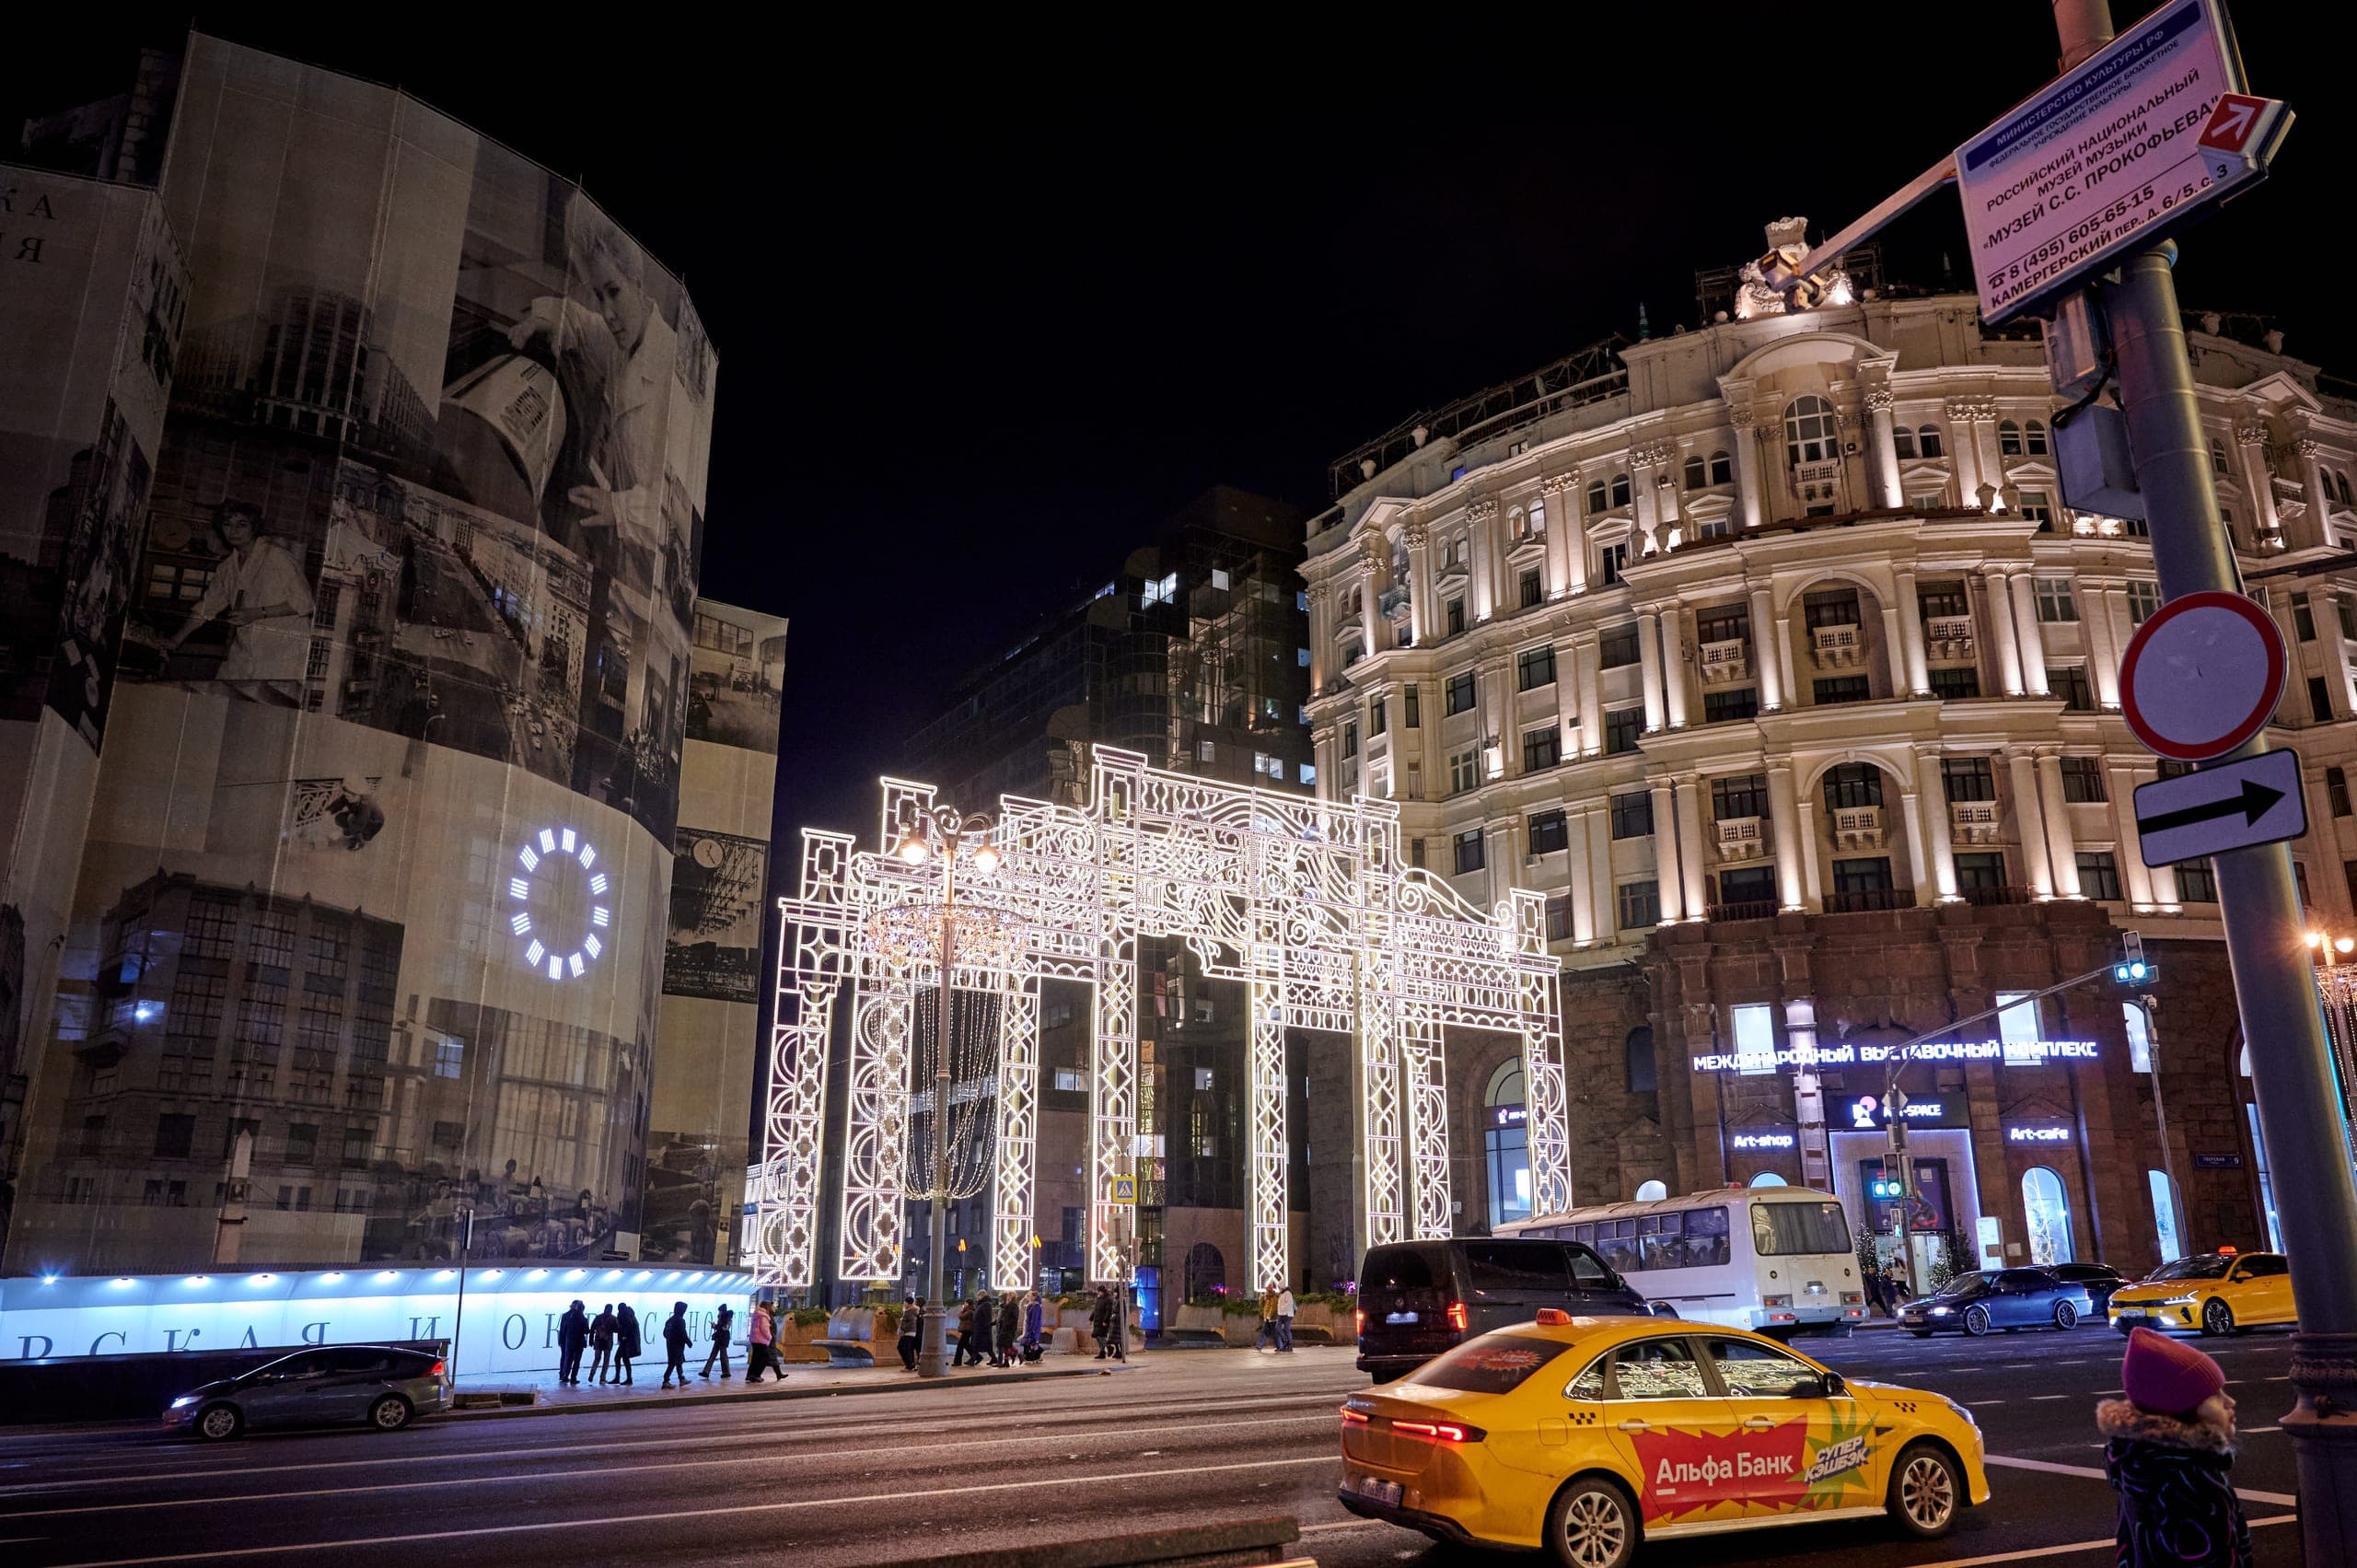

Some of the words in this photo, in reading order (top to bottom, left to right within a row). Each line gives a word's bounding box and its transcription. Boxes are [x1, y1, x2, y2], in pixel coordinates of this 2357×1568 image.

[1989, 127, 2044, 168] ФЕДЕРАЛЬНОЕ
[2045, 77, 2123, 133] ГОСУДАРСТВЕННОЕ
[2124, 39, 2180, 80] БЮДЖЕТНОЕ
[1996, 85, 2083, 146] МИНИСТЕРСТВО
[2084, 44, 2144, 88] КУЛЬТУРЫ
[2146, 30, 2165, 46] РФ
[2033, 111, 2088, 149] УЧРЕЖДЕНИЕ
[2088, 82, 2132, 114] КУЛЬТУРЫ
[1987, 147, 2075, 212] РОССИЙСКИЙ
[2078, 68, 2200, 155] НАЦИОНАЛЬНЫЙ
[2037, 160, 2083, 197] МУЗЕЙ
[2085, 121, 2147, 168] МУЗЫКИ
[1983, 202, 2045, 250] «МУЗЕЙ
[2049, 185, 2081, 210] С.С.
[1991, 230, 2112, 308] КАМЕРГЕРСКИЙ
[2216, 164, 2228, 179] 3
[2010, 264, 2020, 279] 8
[2024, 238, 2064, 273] (495)
[2069, 185, 2154, 244] 605-65-15
[1693, 1044, 1854, 1071] МЕЖДУНАРОДНЫЙ
[1860, 1040, 2000, 1062] ВЫСТАВОЧНЫЙ
[2003, 1041, 2097, 1059] КОМПЛЕКС
[1734, 1134, 1793, 1148] Art-shop
[2011, 1127, 2068, 1141] Art-cafe
[1656, 1455, 1733, 1487] Альфа
[1737, 1452, 1794, 1477] Банк
[1804, 1446, 1872, 1485] КЭШБЭК
[1816, 1435, 1865, 1463] СУПЕР
